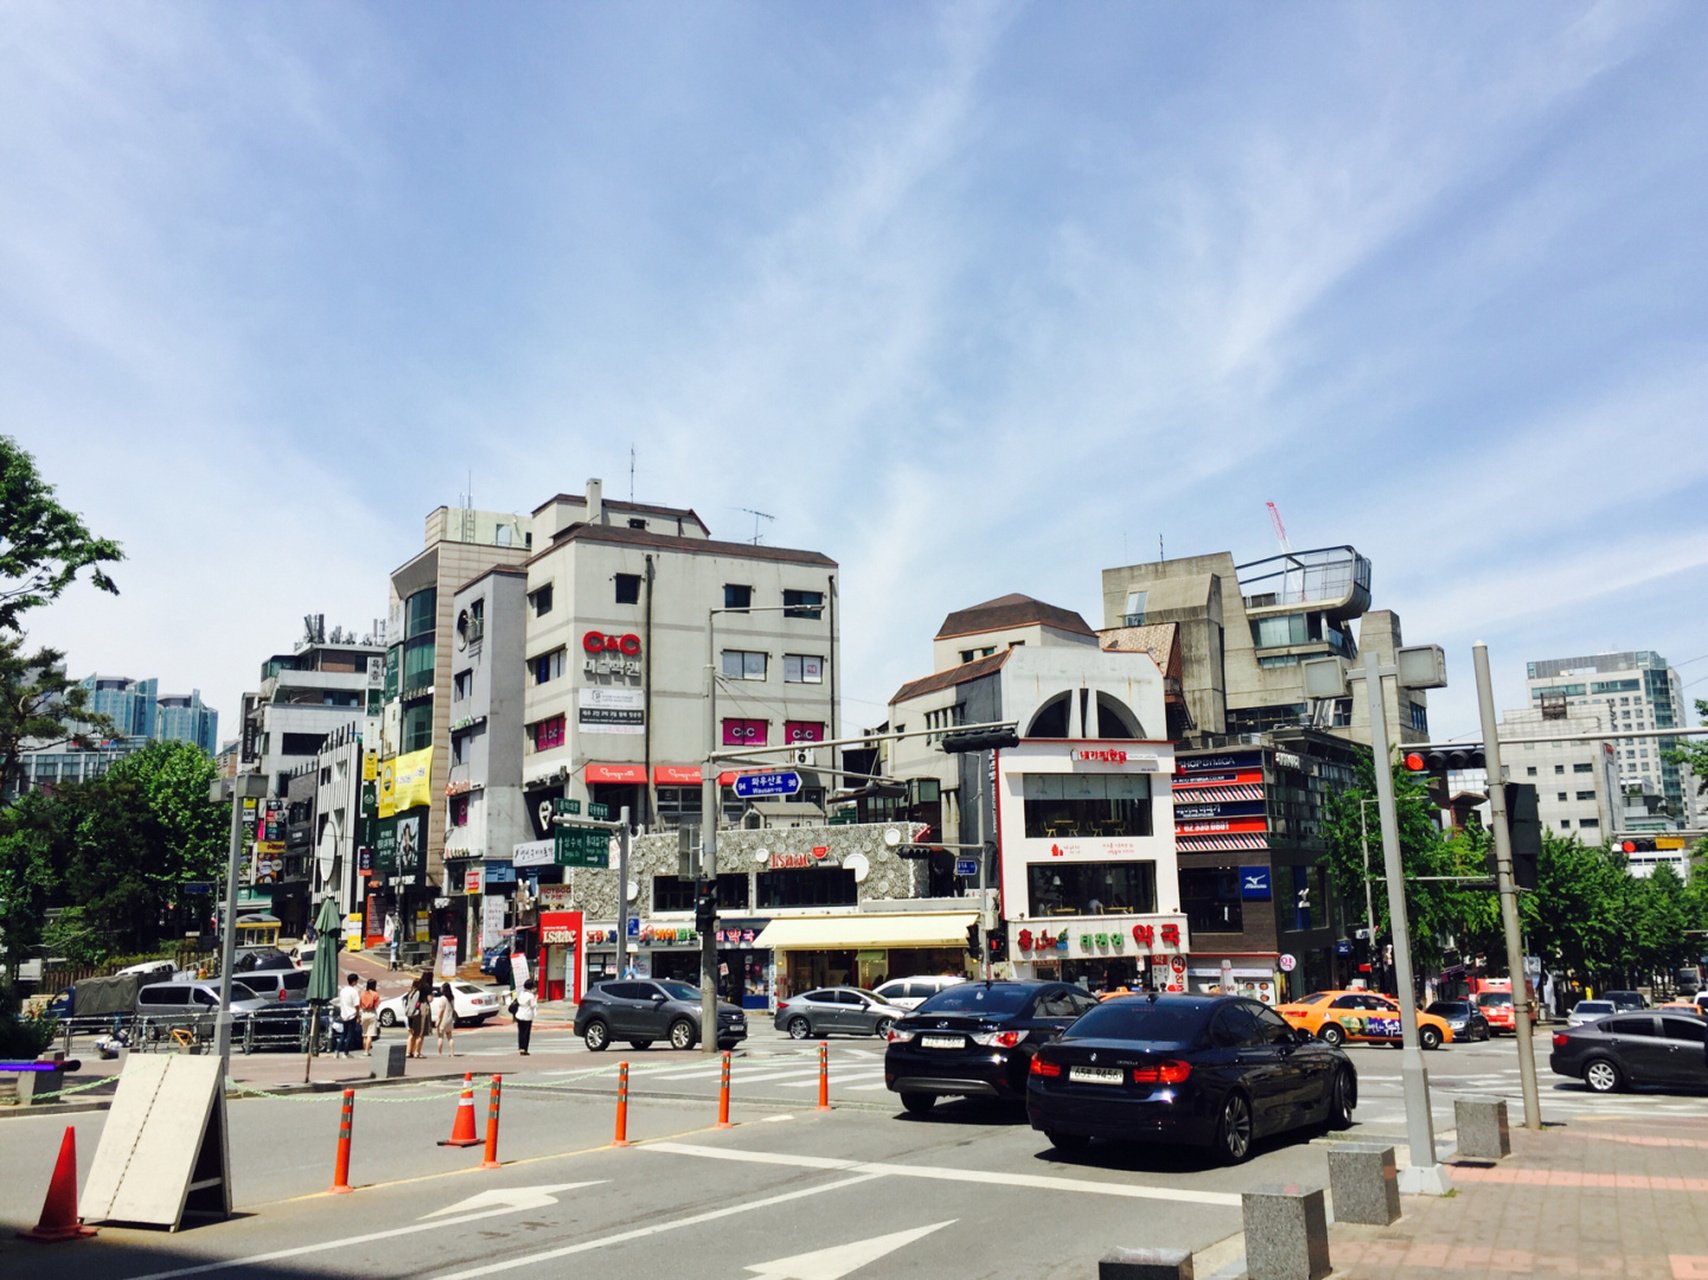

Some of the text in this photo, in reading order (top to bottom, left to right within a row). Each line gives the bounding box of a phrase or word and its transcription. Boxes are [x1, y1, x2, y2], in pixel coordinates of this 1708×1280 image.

[582, 631, 641, 655] C&C
[583, 659, 640, 676] 미술학원
[738, 783, 746, 791] 94
[751, 775, 783, 786] 와우산로
[564, 837, 582, 848] 상수역
[1132, 924, 1180, 948] 약국
[1173, 958, 1184, 971] 약
[1280, 956, 1293, 969] 약
[1095, 1068, 1118, 1080] 9456
